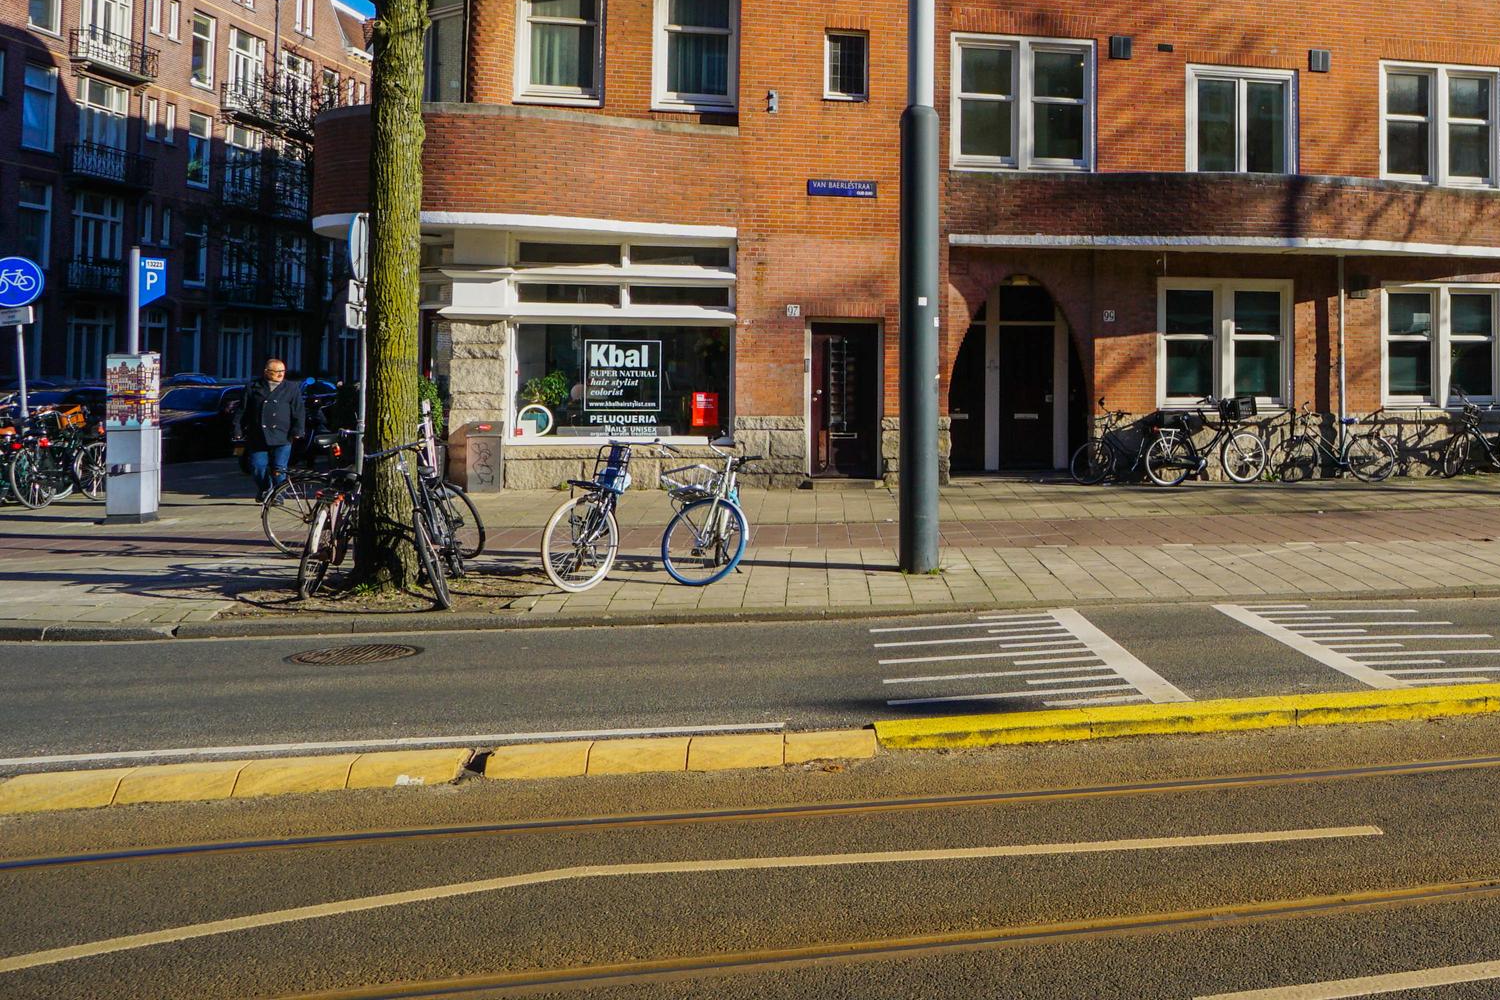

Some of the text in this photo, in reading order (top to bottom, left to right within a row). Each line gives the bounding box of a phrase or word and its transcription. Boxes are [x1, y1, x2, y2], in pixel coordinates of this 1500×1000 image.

[146, 272, 157, 290] P
[788, 306, 798, 316] 97
[591, 344, 648, 367] Kbal
[611, 378, 638, 387] stylist
[590, 415, 656, 424] PELUQUERIA
